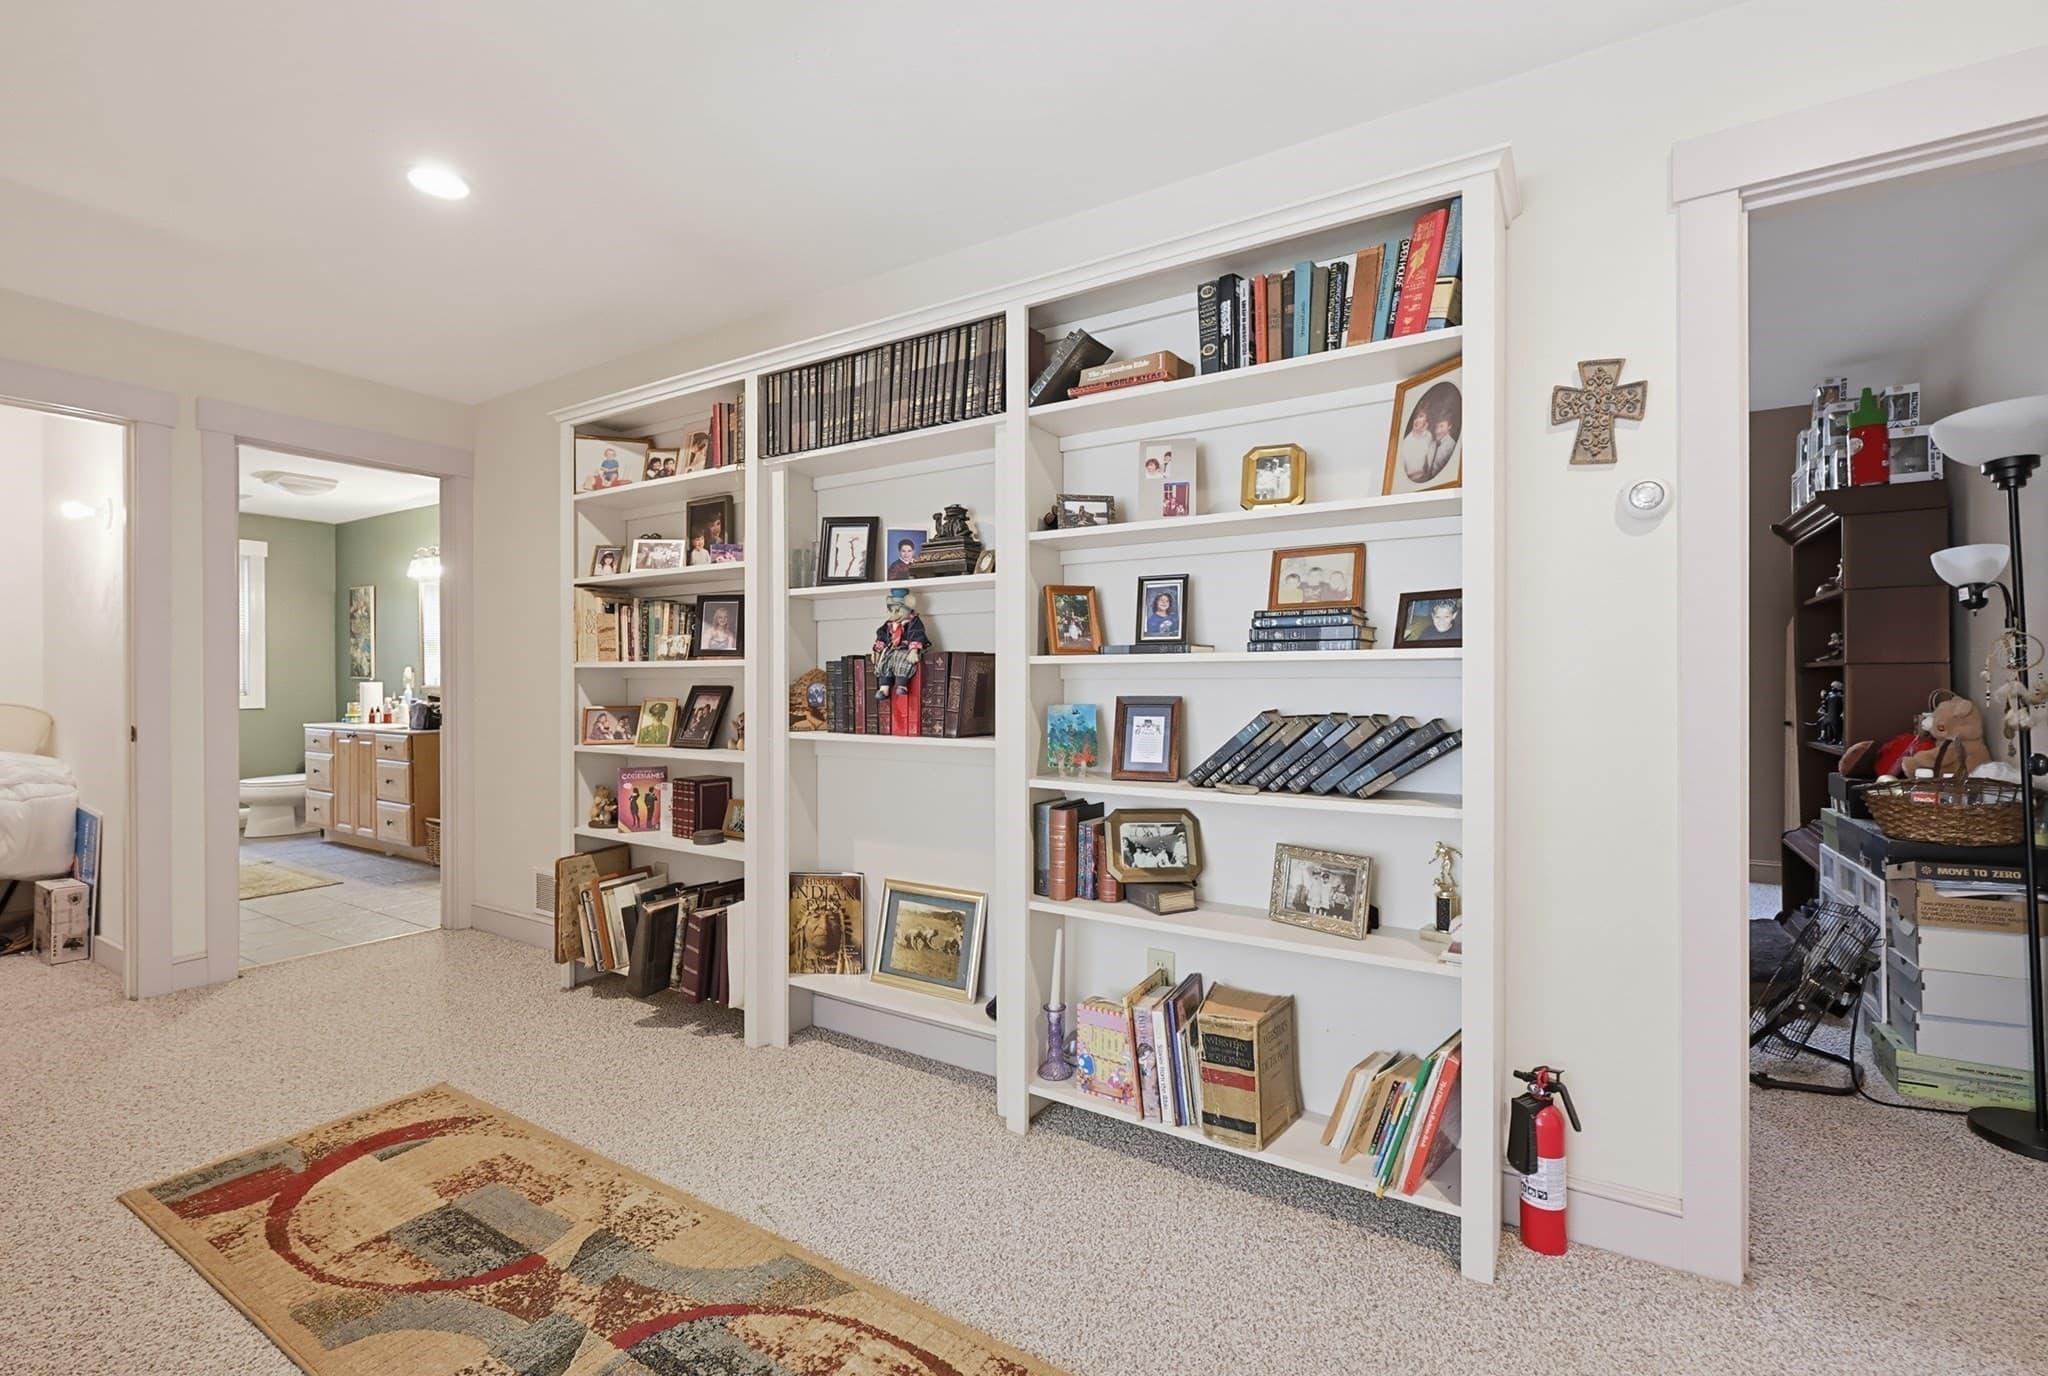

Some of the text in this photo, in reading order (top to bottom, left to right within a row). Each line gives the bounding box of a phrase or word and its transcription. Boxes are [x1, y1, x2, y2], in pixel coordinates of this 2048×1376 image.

[1105, 377, 1134, 387] WORLD
[621, 771, 665, 780] CODENAMES
[1936, 866, 2022, 880] MOVE TO ZERO
